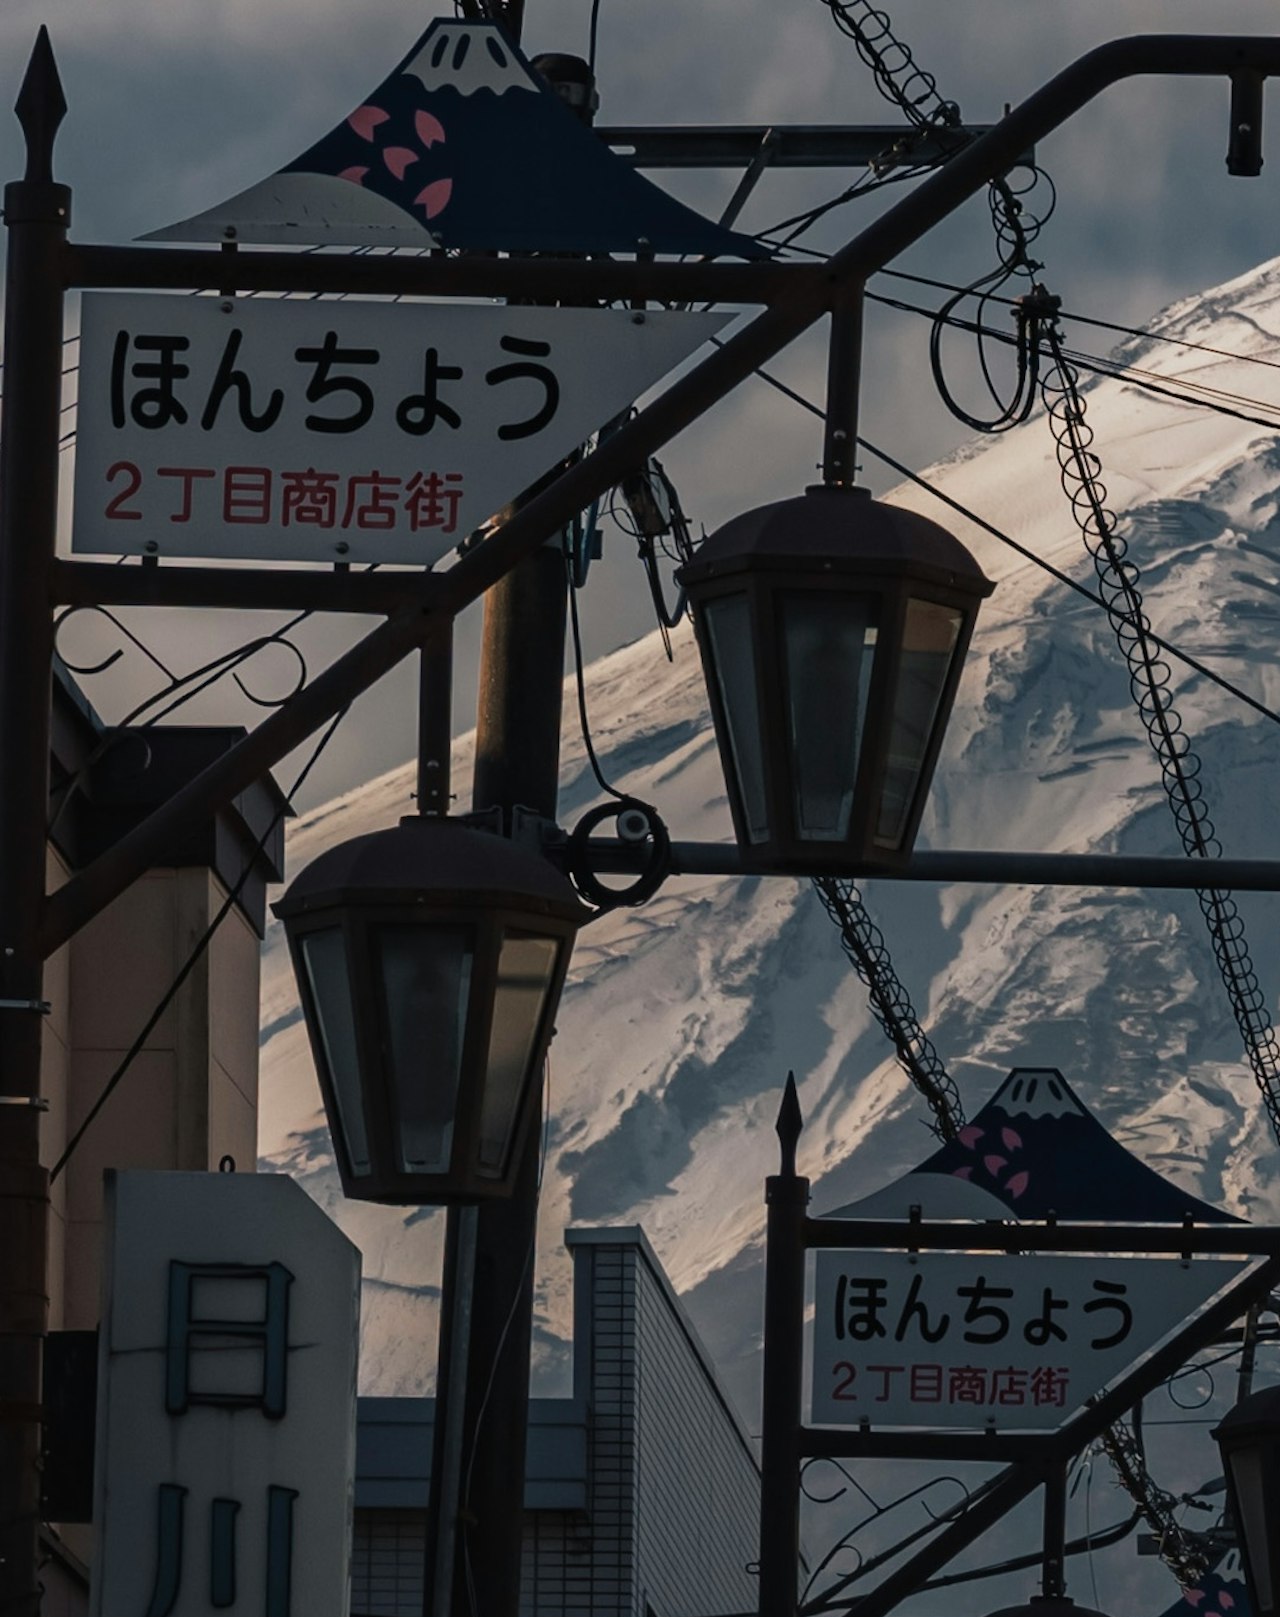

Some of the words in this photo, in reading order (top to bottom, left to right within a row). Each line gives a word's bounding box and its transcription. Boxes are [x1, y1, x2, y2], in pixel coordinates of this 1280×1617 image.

[111, 328, 560, 442] ほんちょう
[104, 461, 465, 534] 2丁目商店街
[835, 1275, 1133, 1350] ほんちょう
[832, 1361, 1070, 1407] 2丁目商店街
